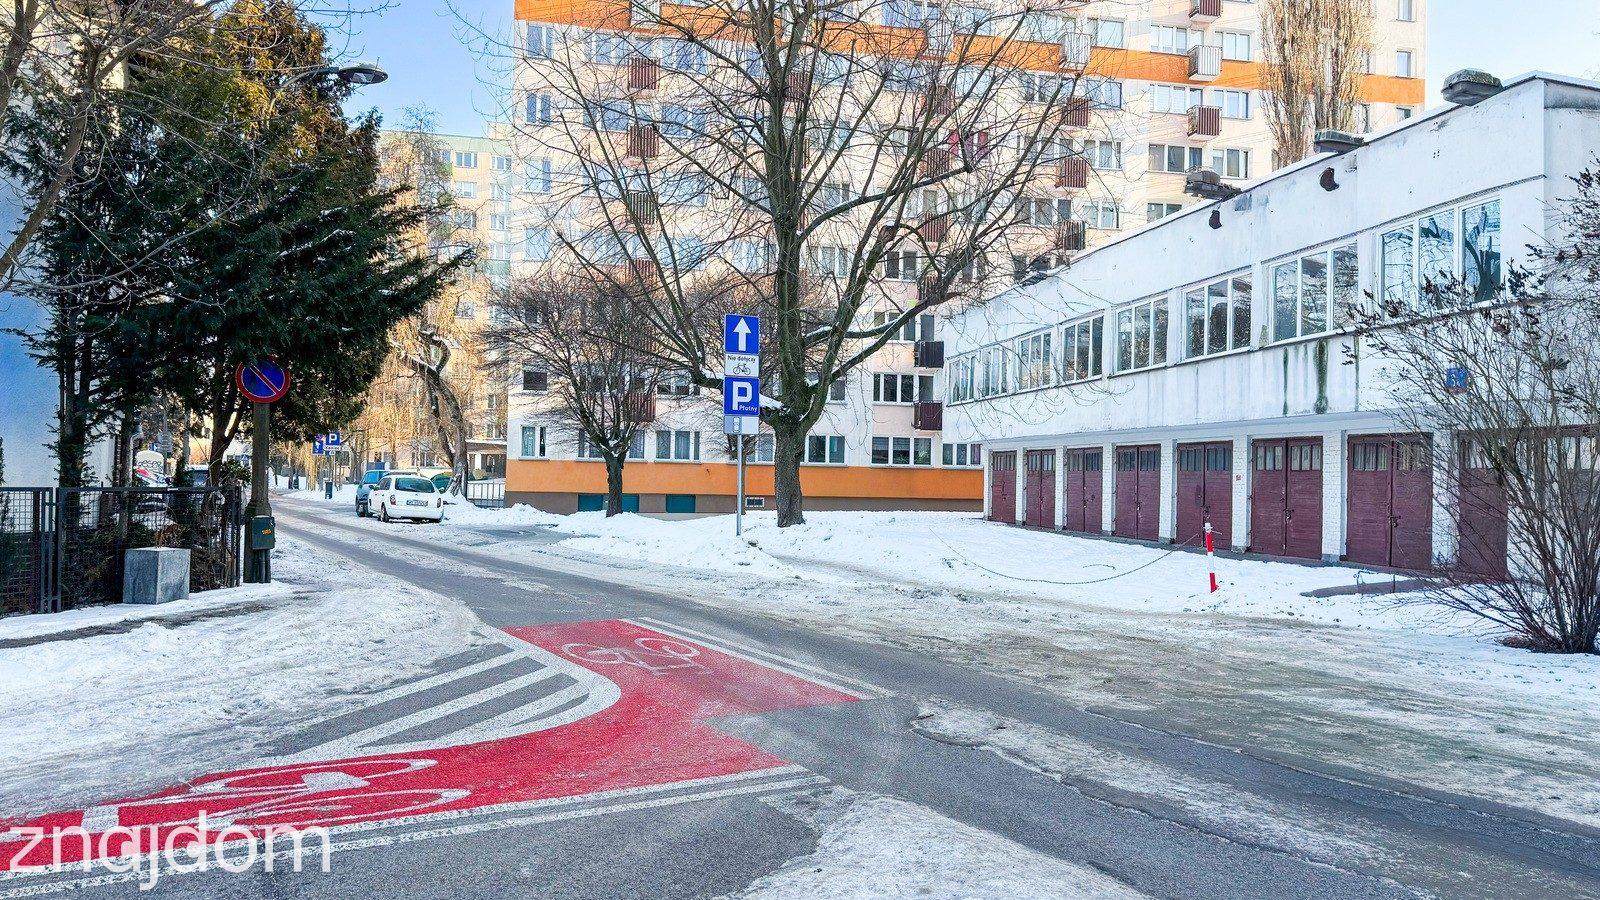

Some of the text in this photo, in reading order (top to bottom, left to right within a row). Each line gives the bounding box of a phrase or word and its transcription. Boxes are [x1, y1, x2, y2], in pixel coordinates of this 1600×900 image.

[737, 355, 756, 364] dotyczy
[732, 381, 753, 411] P
[738, 404, 758, 413] Płatny
[329, 433, 338, 444] P
